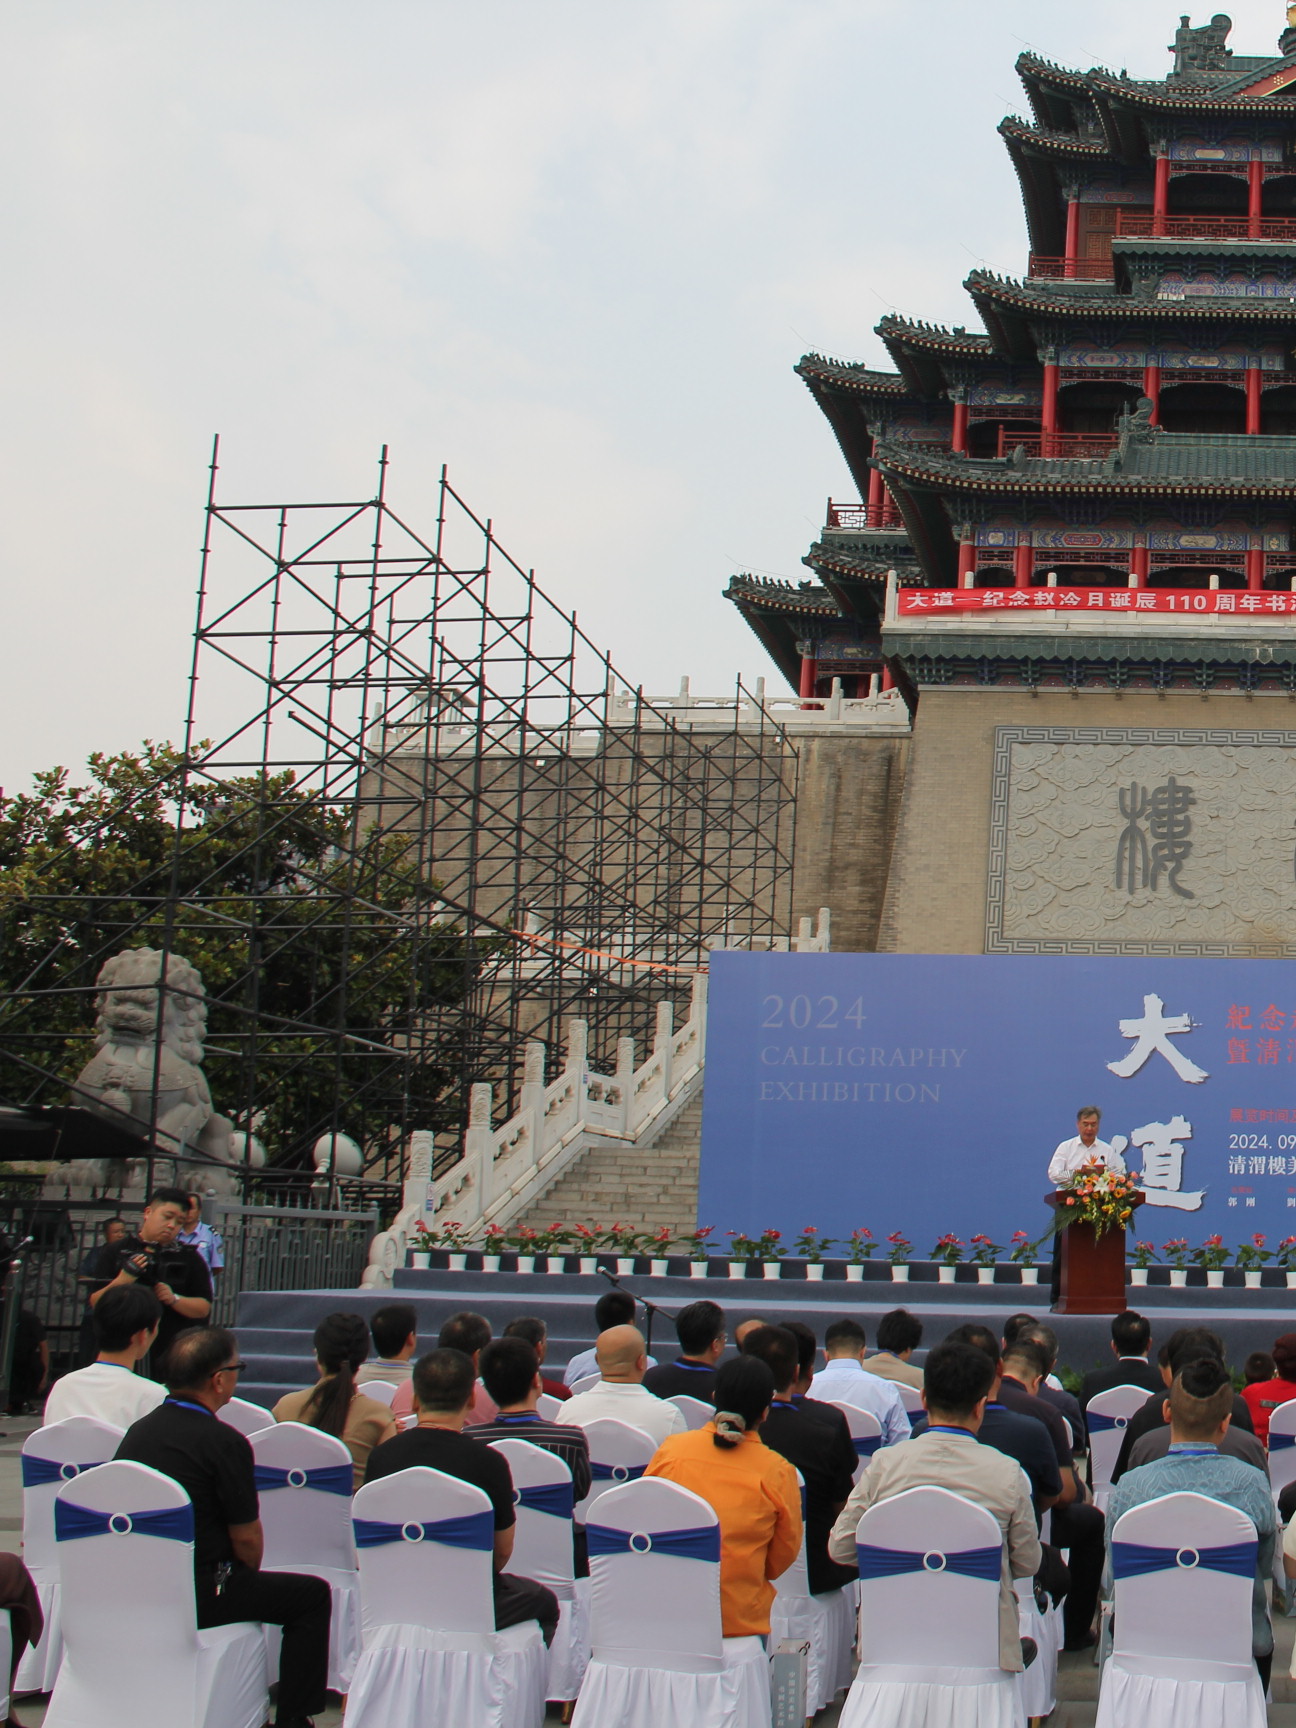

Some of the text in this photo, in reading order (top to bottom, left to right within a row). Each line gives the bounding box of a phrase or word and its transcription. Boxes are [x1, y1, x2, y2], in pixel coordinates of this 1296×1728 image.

[761, 995, 867, 1029] 2024
[760, 1046, 968, 1068] CALLIGRAPHY
[759, 1081, 942, 1103] EXHIBITION
